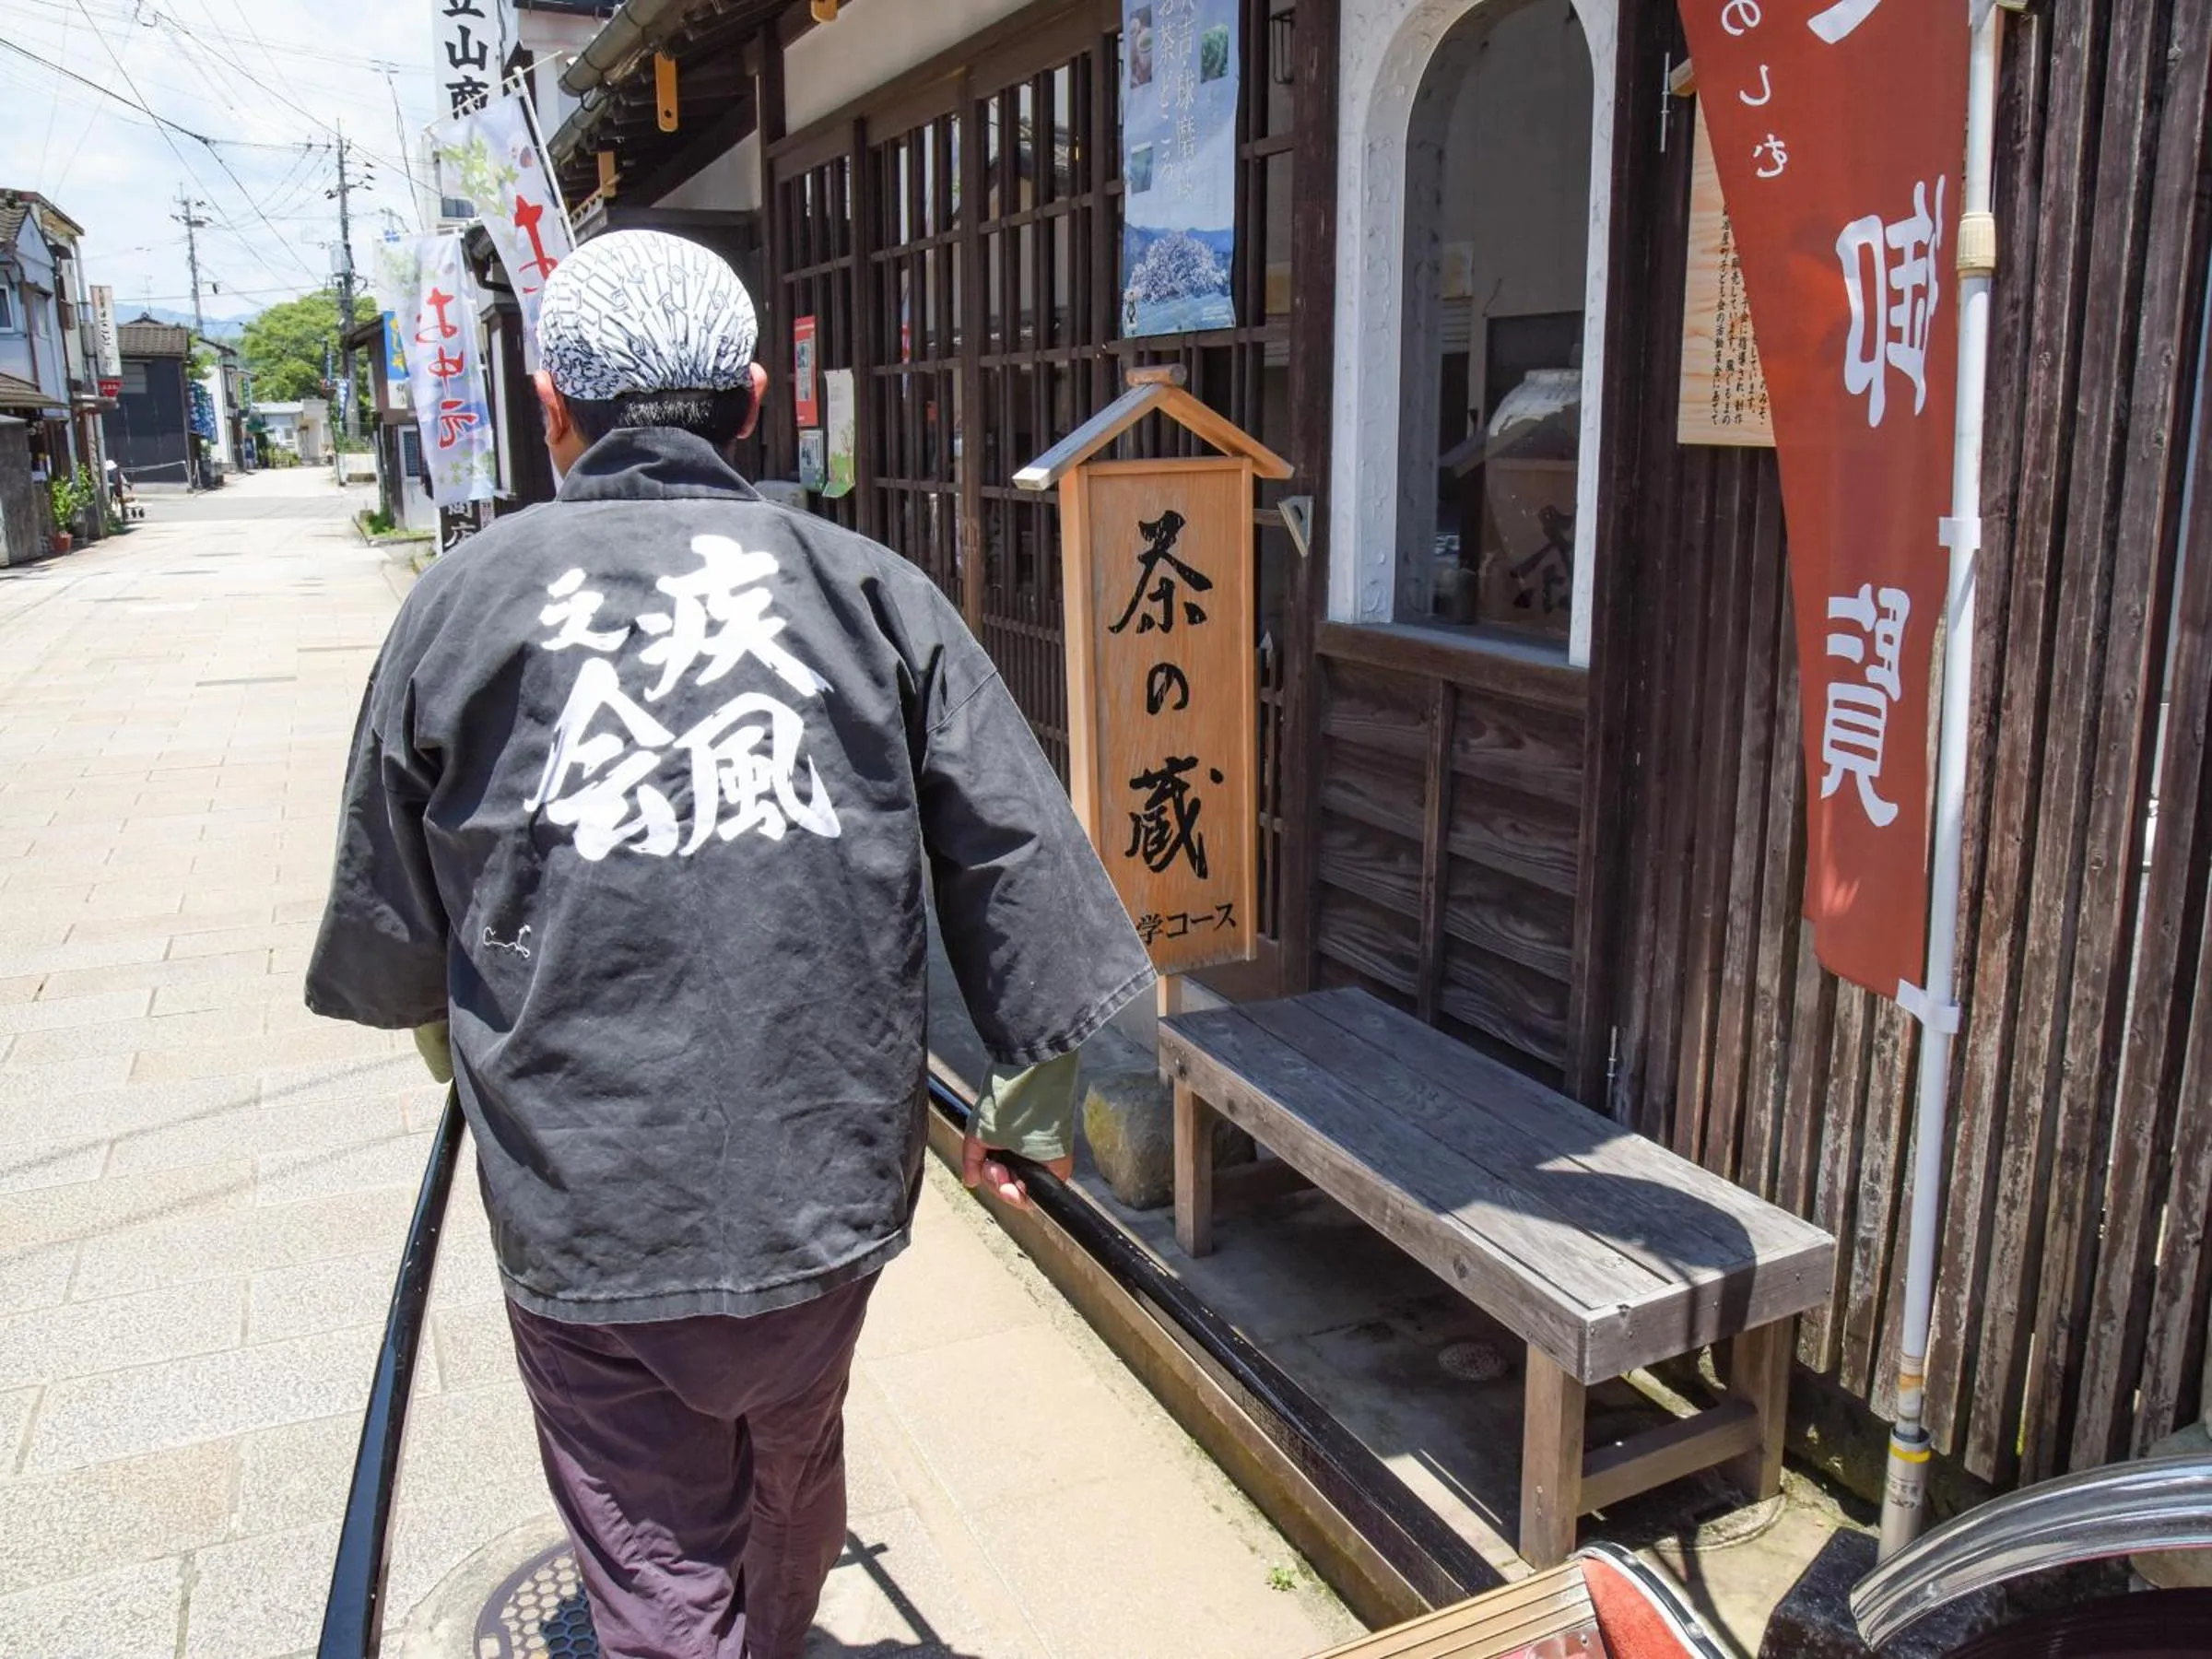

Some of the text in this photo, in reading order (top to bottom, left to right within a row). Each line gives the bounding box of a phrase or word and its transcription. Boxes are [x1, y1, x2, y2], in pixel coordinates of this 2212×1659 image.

[415, 288, 480, 450] お中元
[1108, 509, 1224, 879] 茶の蔵
